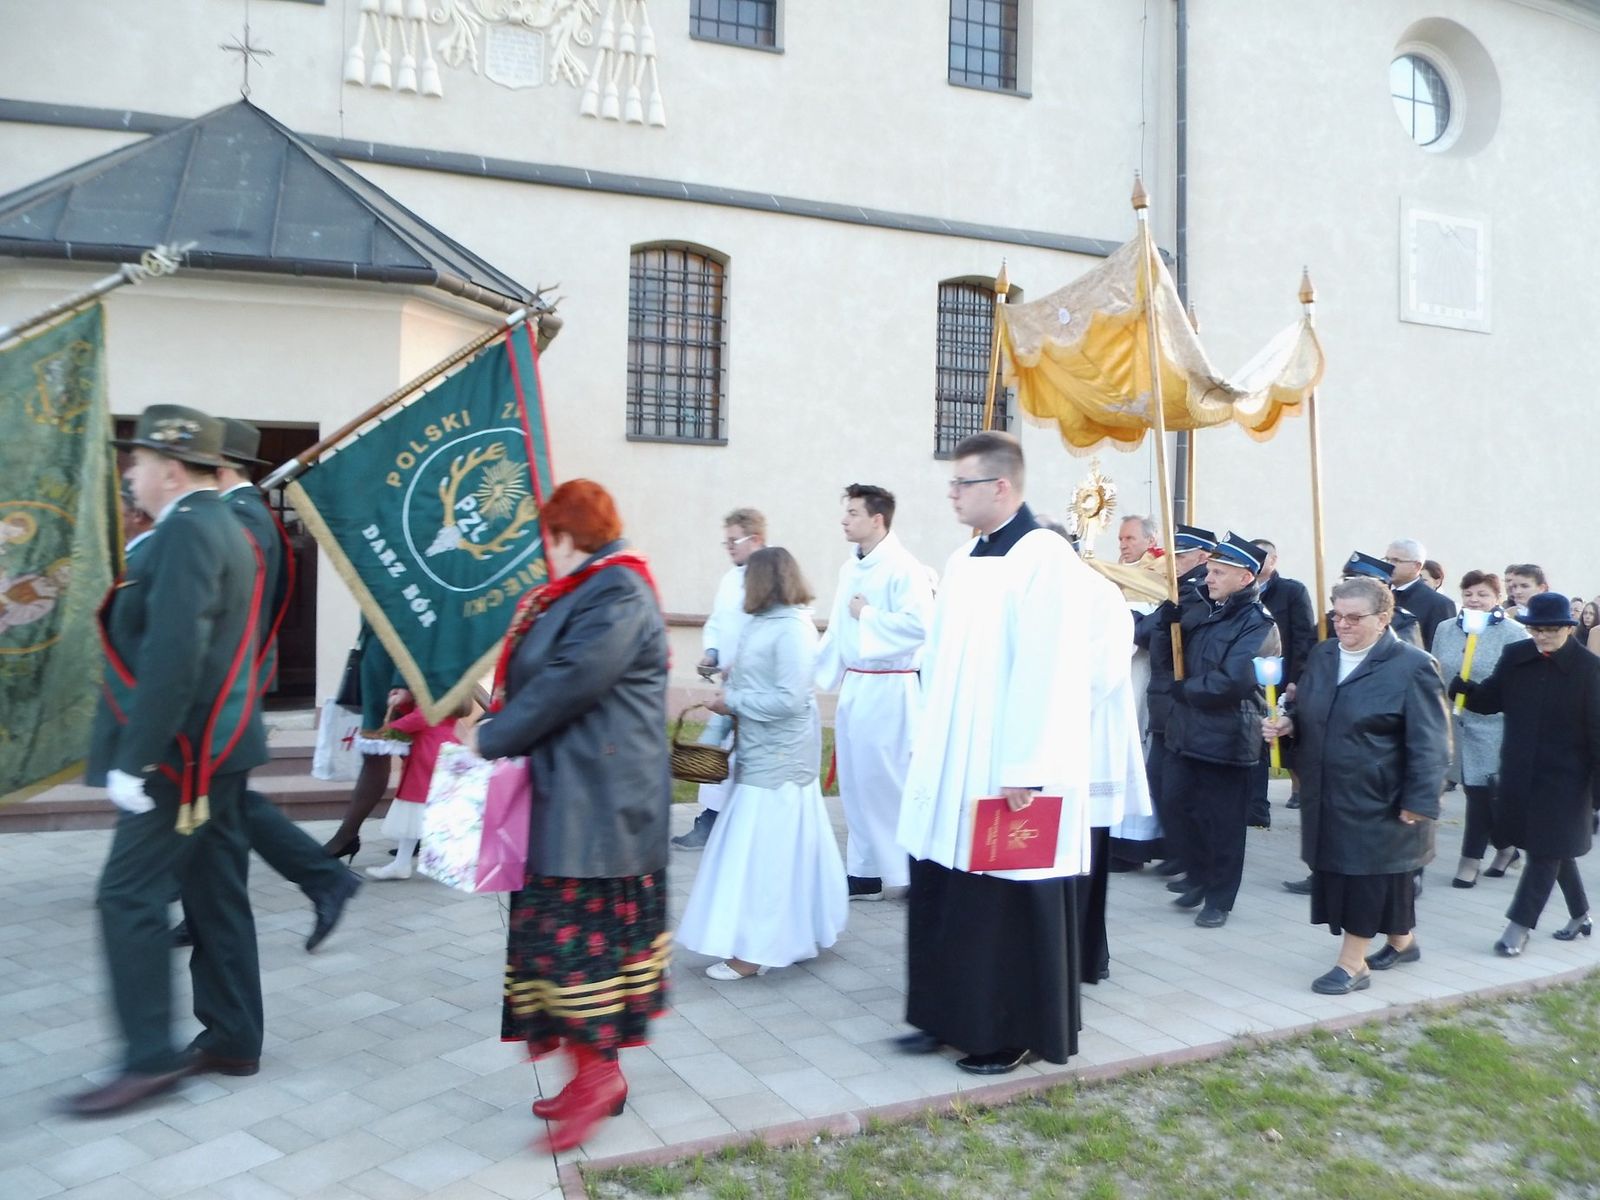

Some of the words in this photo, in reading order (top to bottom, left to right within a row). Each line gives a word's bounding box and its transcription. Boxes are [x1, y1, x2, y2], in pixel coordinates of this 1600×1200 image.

[386, 410, 471, 487] POLSKI
[362, 524, 407, 578] DARZ
[401, 583, 437, 628] BÓR
